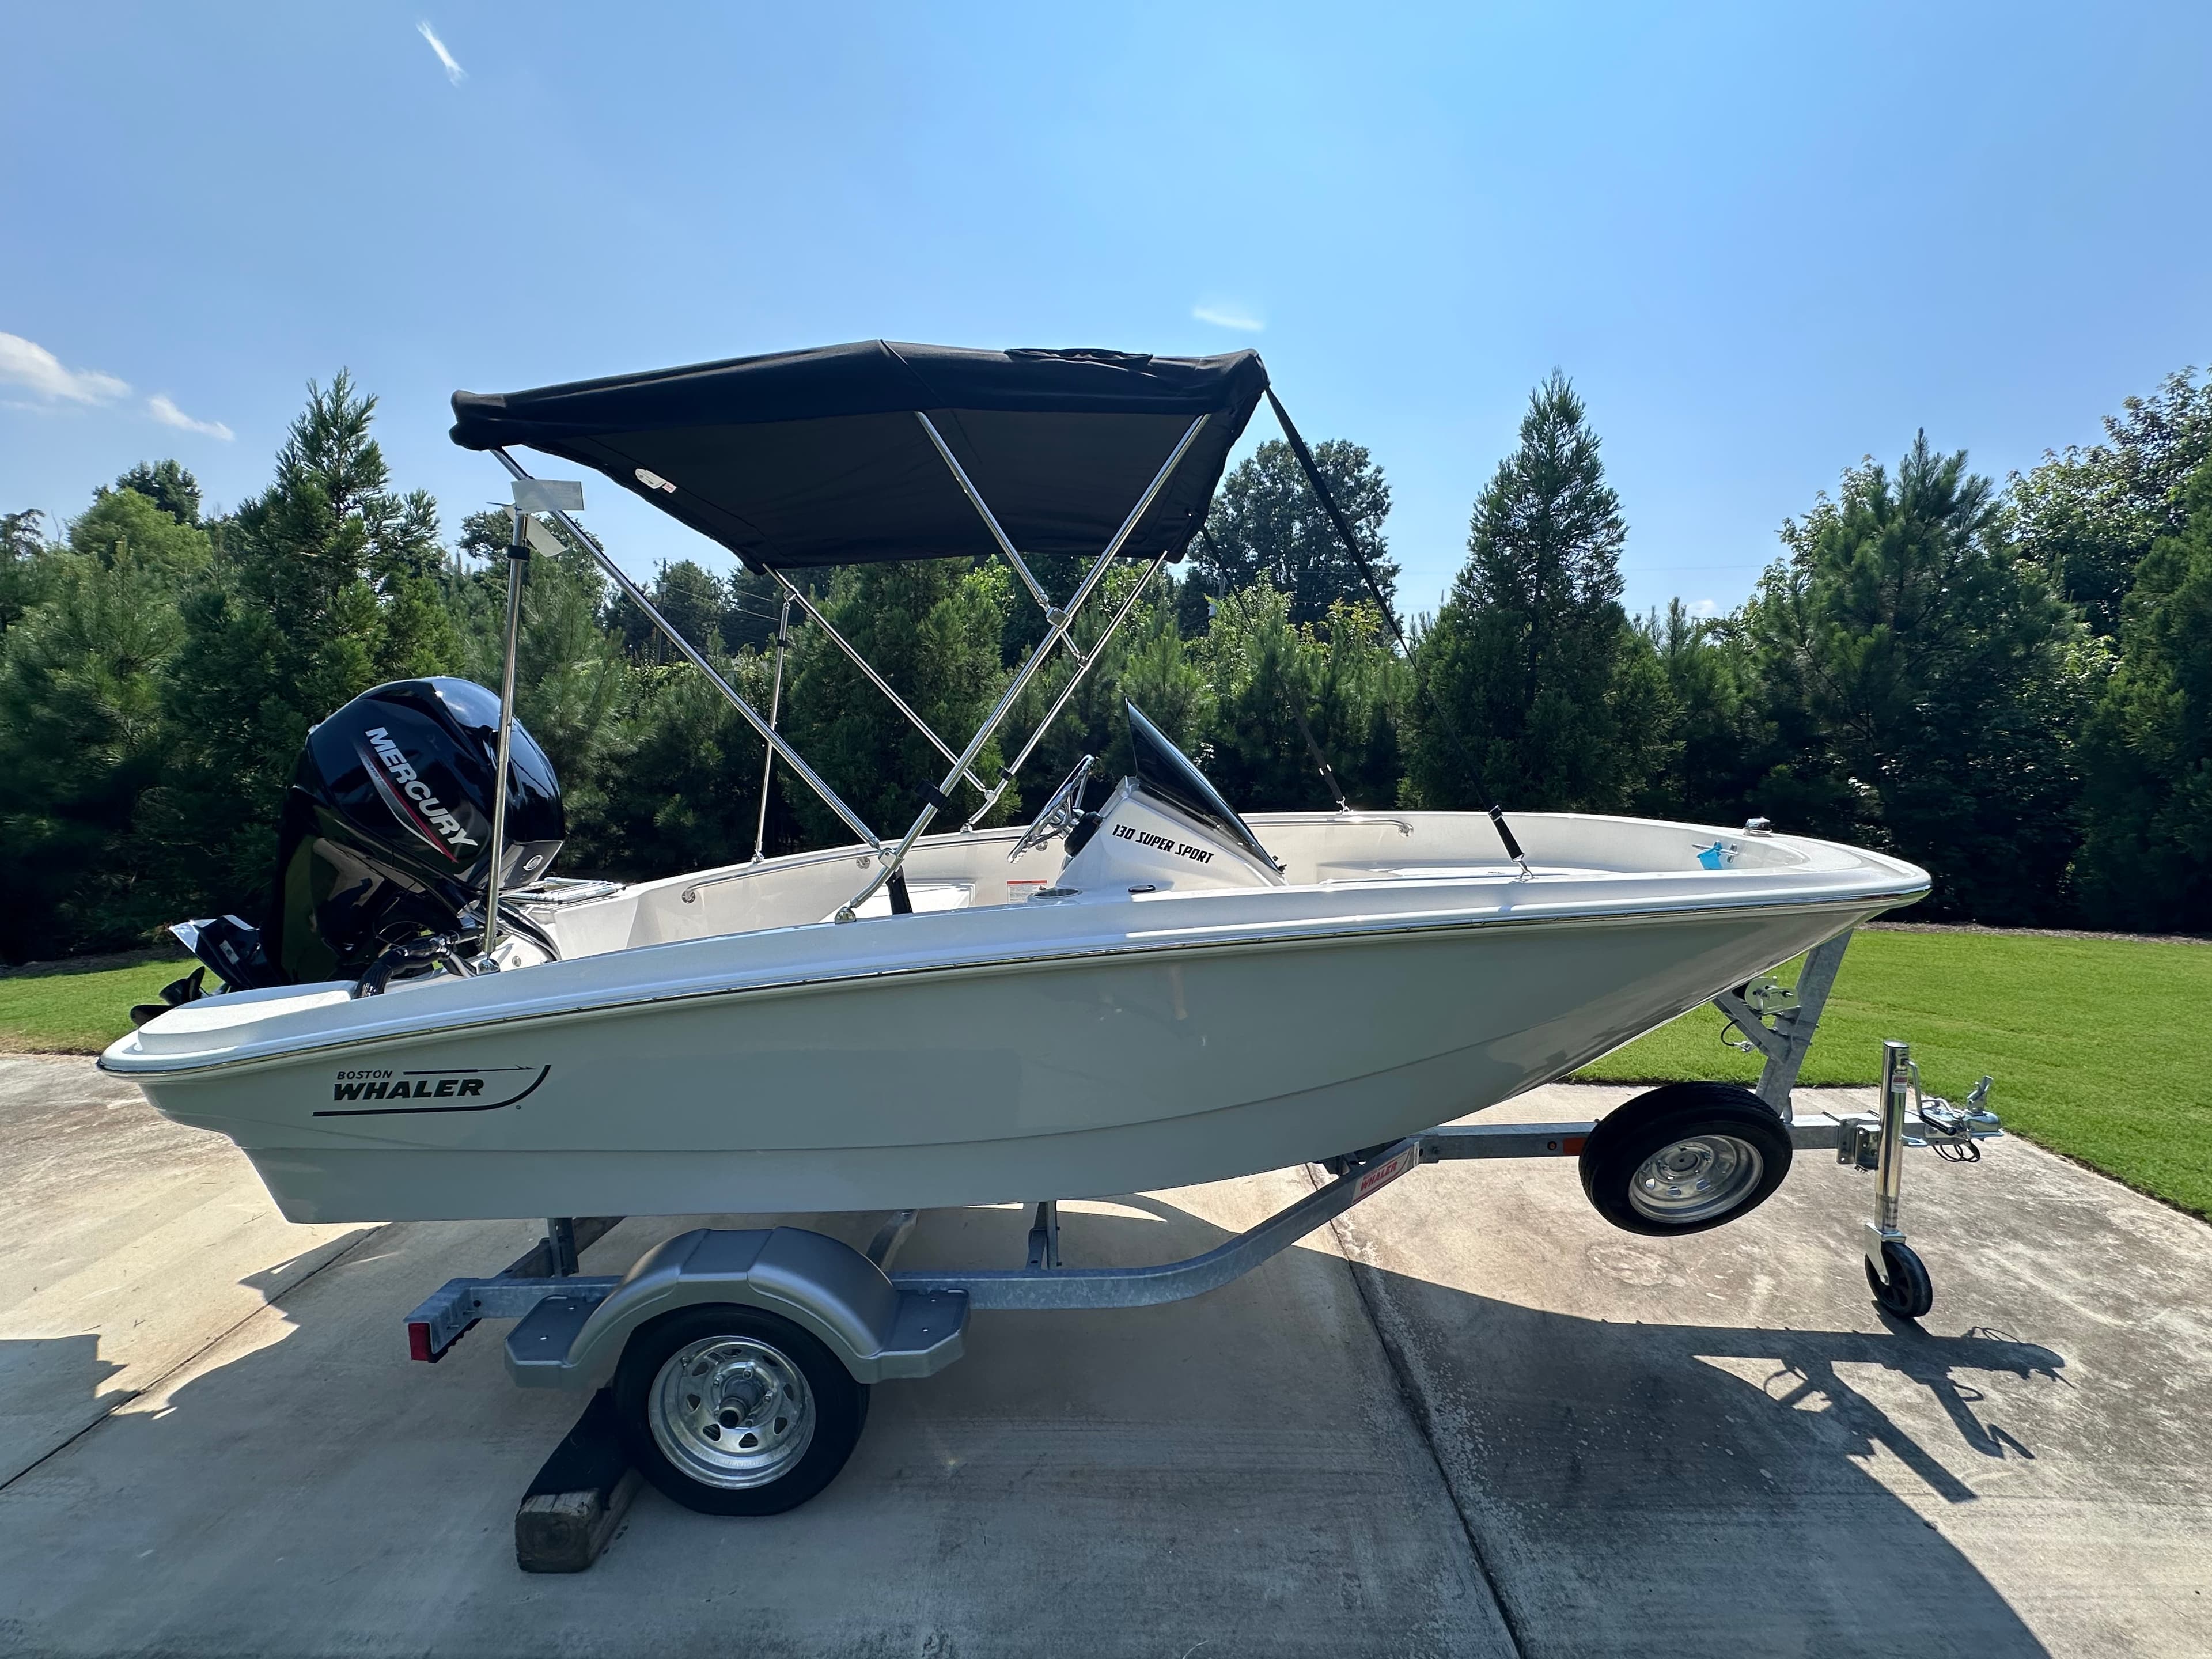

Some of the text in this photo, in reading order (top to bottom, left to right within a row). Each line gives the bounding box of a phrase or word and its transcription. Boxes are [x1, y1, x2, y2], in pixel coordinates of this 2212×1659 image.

[365, 726, 479, 847] MERCURY
[1112, 824, 1214, 864] 130 SUPER SPORT
[334, 1078, 484, 1101] WHALER
[337, 1070, 393, 1080] BOSTON
[1360, 1161, 1397, 1191] WHALER
